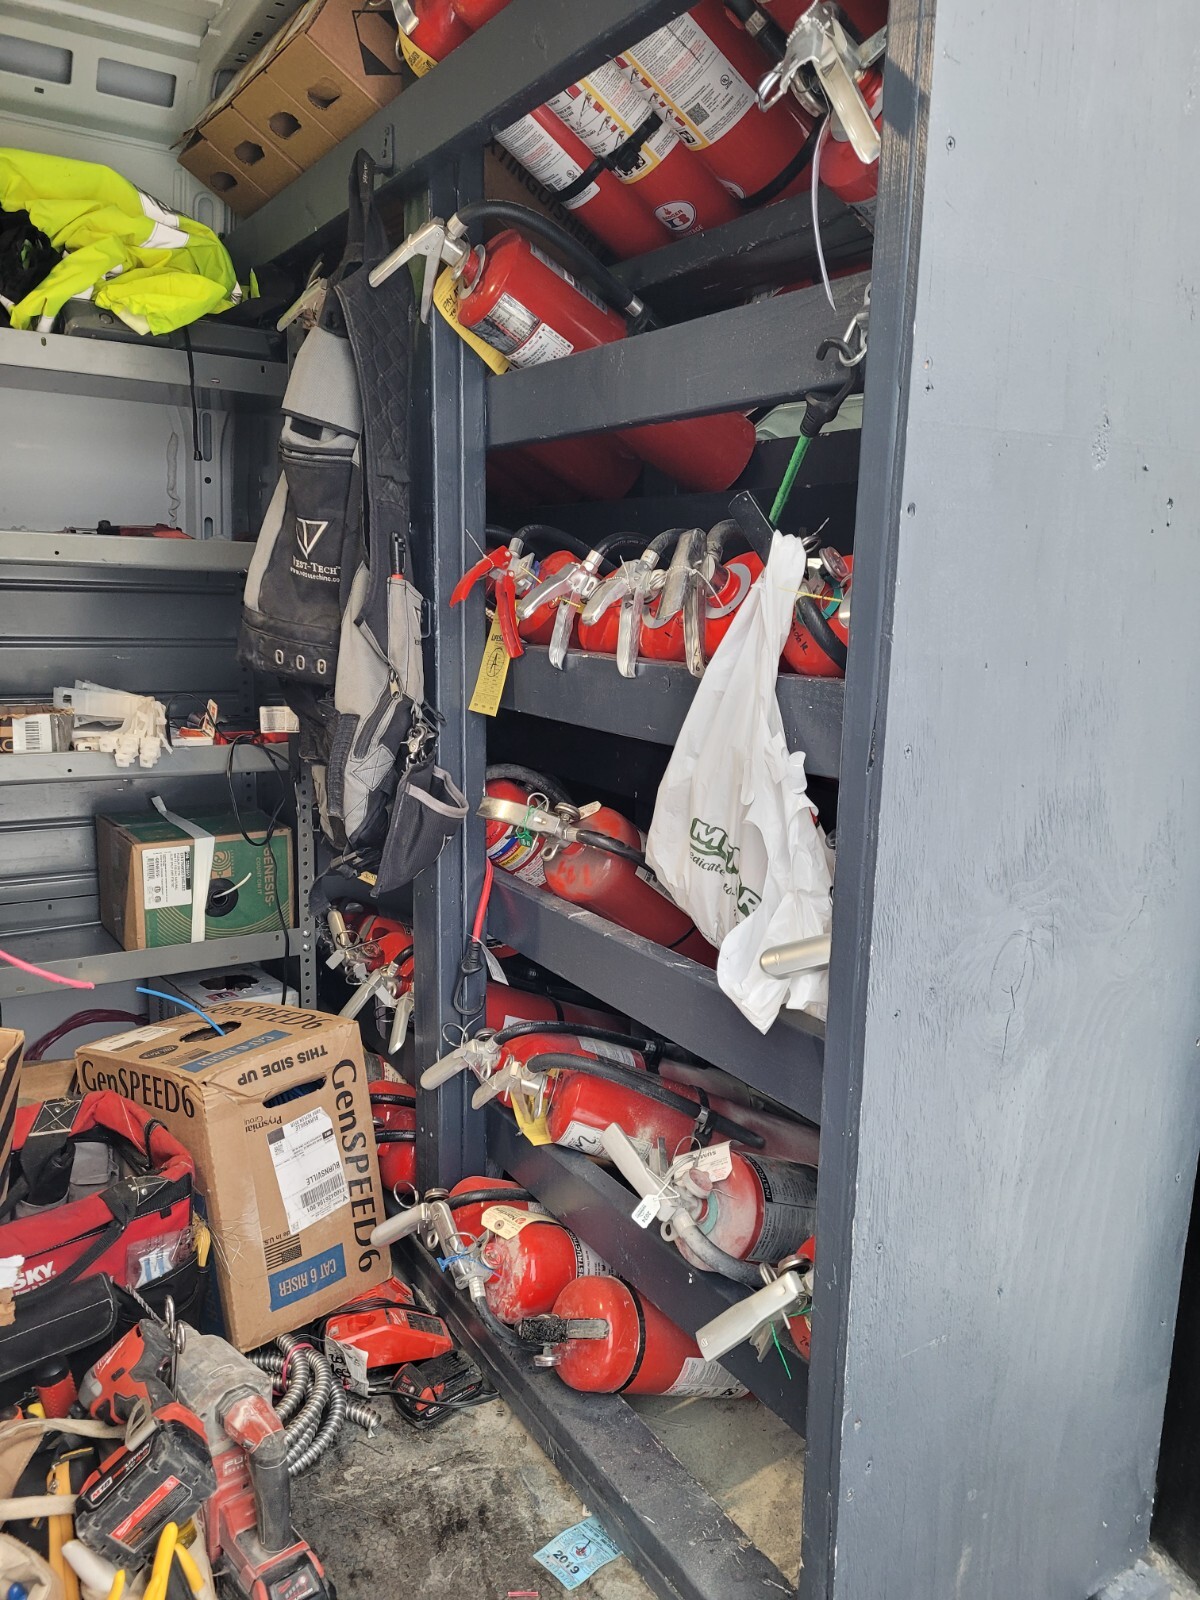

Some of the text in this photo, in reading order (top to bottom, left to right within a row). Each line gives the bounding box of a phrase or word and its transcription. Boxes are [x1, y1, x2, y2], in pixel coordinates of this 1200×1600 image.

[263, 847, 274, 904] GENESIS
[237, 1044, 329, 1086] THIS SIDE UP
[305, 1160, 341, 1185] BURNSVILLE
[13, 1261, 54, 1291] SKY
[278, 1257, 338, 1297] CAT 6 RISER
[552, 1549, 580, 1575] 2019
